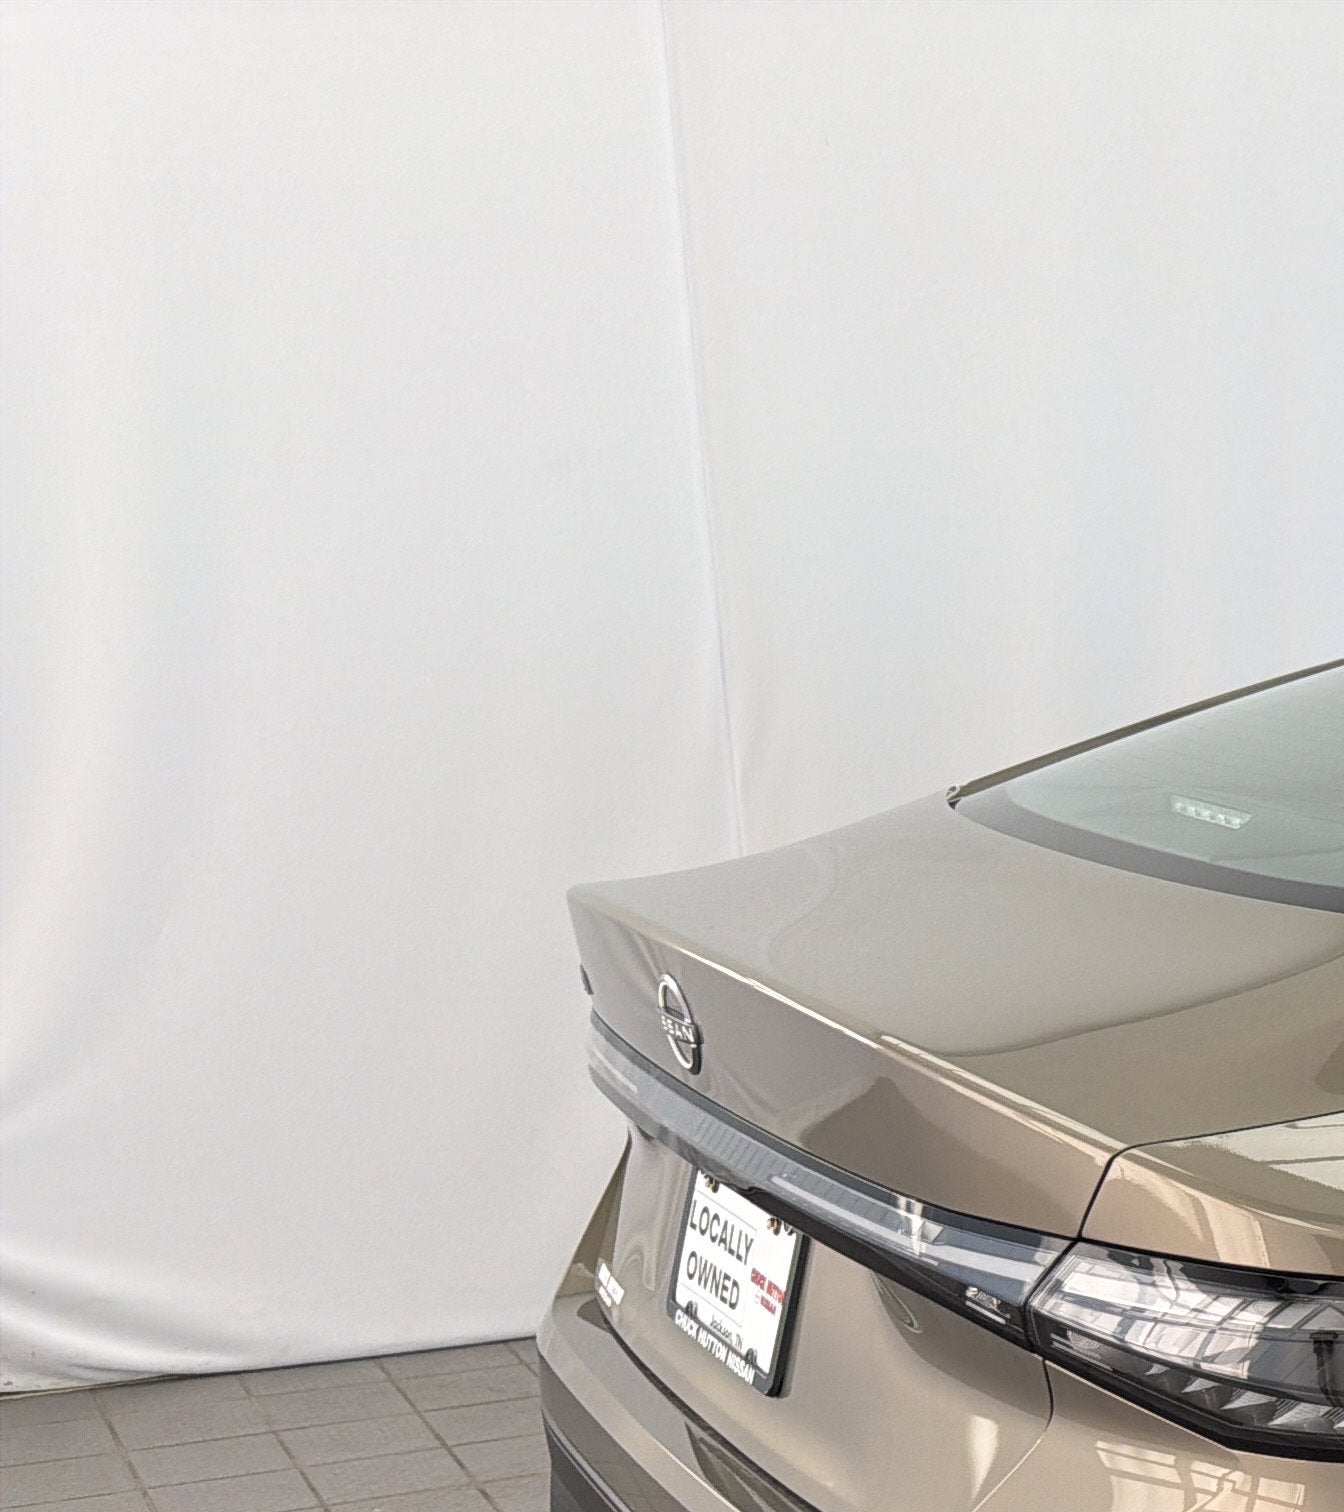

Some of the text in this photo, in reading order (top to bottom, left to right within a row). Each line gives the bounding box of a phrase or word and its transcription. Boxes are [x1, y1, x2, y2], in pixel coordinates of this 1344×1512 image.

[690, 1199, 754, 1266] LOCALLY
[686, 1250, 741, 1311] OWNED
[674, 1309, 756, 1386] CHUCK HUTTON NISSAN
